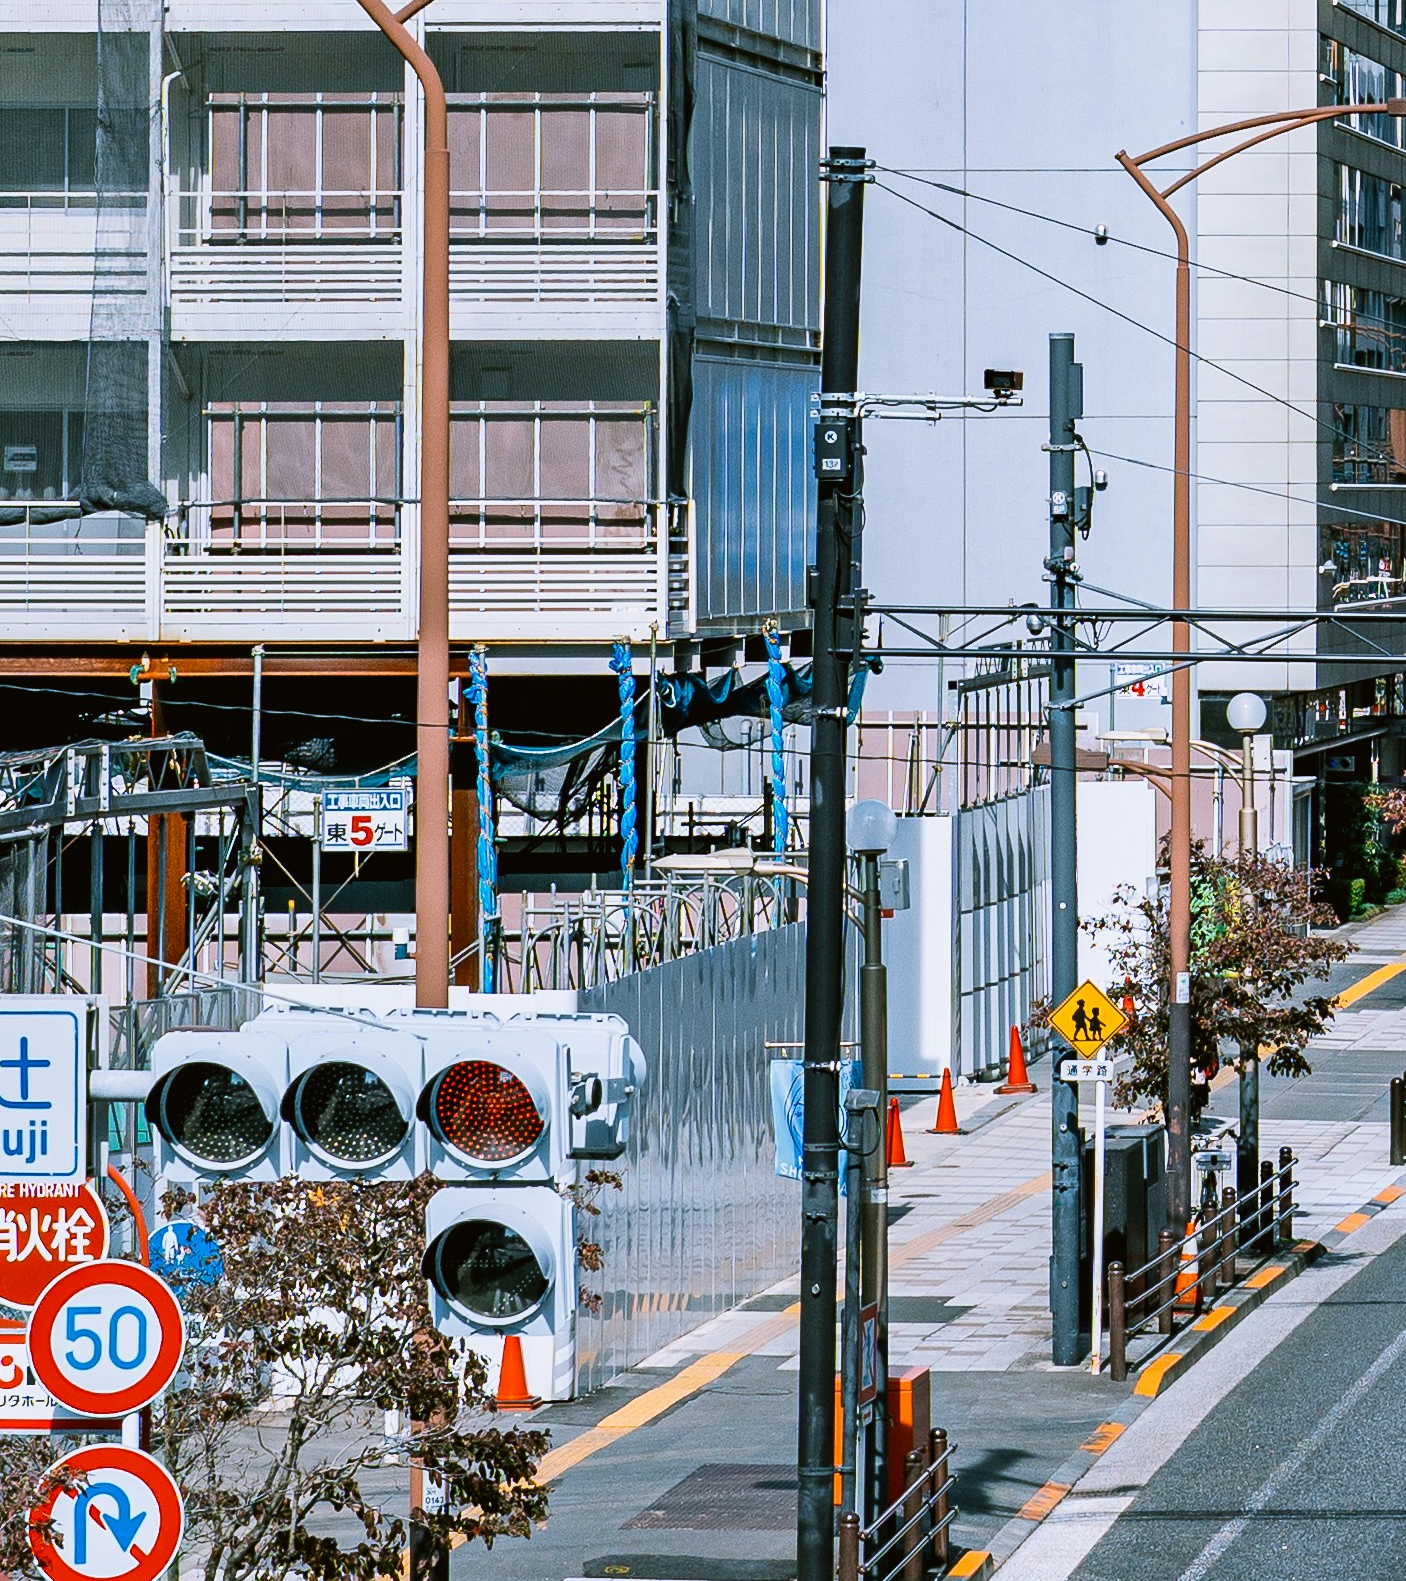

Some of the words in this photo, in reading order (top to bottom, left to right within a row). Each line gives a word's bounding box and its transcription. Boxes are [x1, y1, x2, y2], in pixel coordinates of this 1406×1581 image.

[326, 815, 403, 847] 東5ゲート
[1066, 1064, 1107, 1077] 通学路
[3, 1120, 48, 1164] uji
[0, 1183, 15, 1198] RE
[19, 1183, 80, 1198] HYDRANT
[65, 1305, 147, 1371] 50
